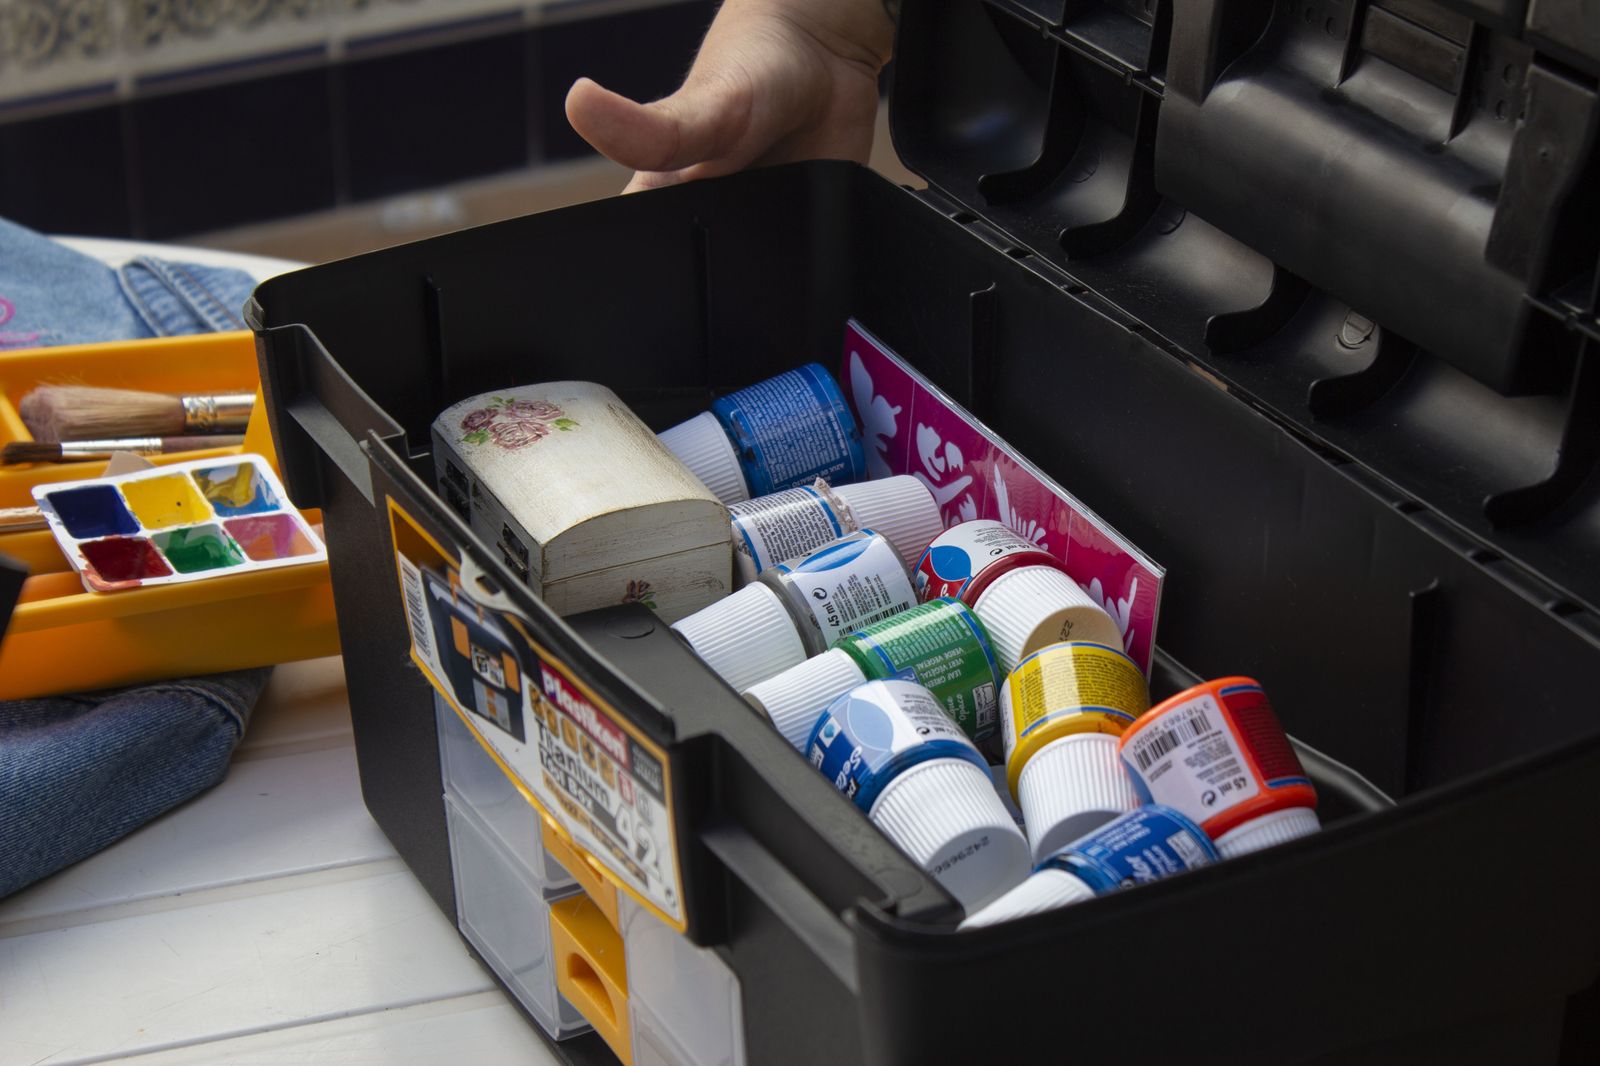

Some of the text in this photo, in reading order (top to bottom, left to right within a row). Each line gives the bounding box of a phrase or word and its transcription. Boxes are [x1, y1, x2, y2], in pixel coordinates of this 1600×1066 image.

[822, 600, 840, 628] 45 ml
[916, 647, 963, 669] VERDE VEGETAL
[924, 677, 945, 688] GREEN
[543, 671, 628, 765] Plastiken
[535, 716, 610, 810] Titanium
[566, 773, 593, 814] Box
